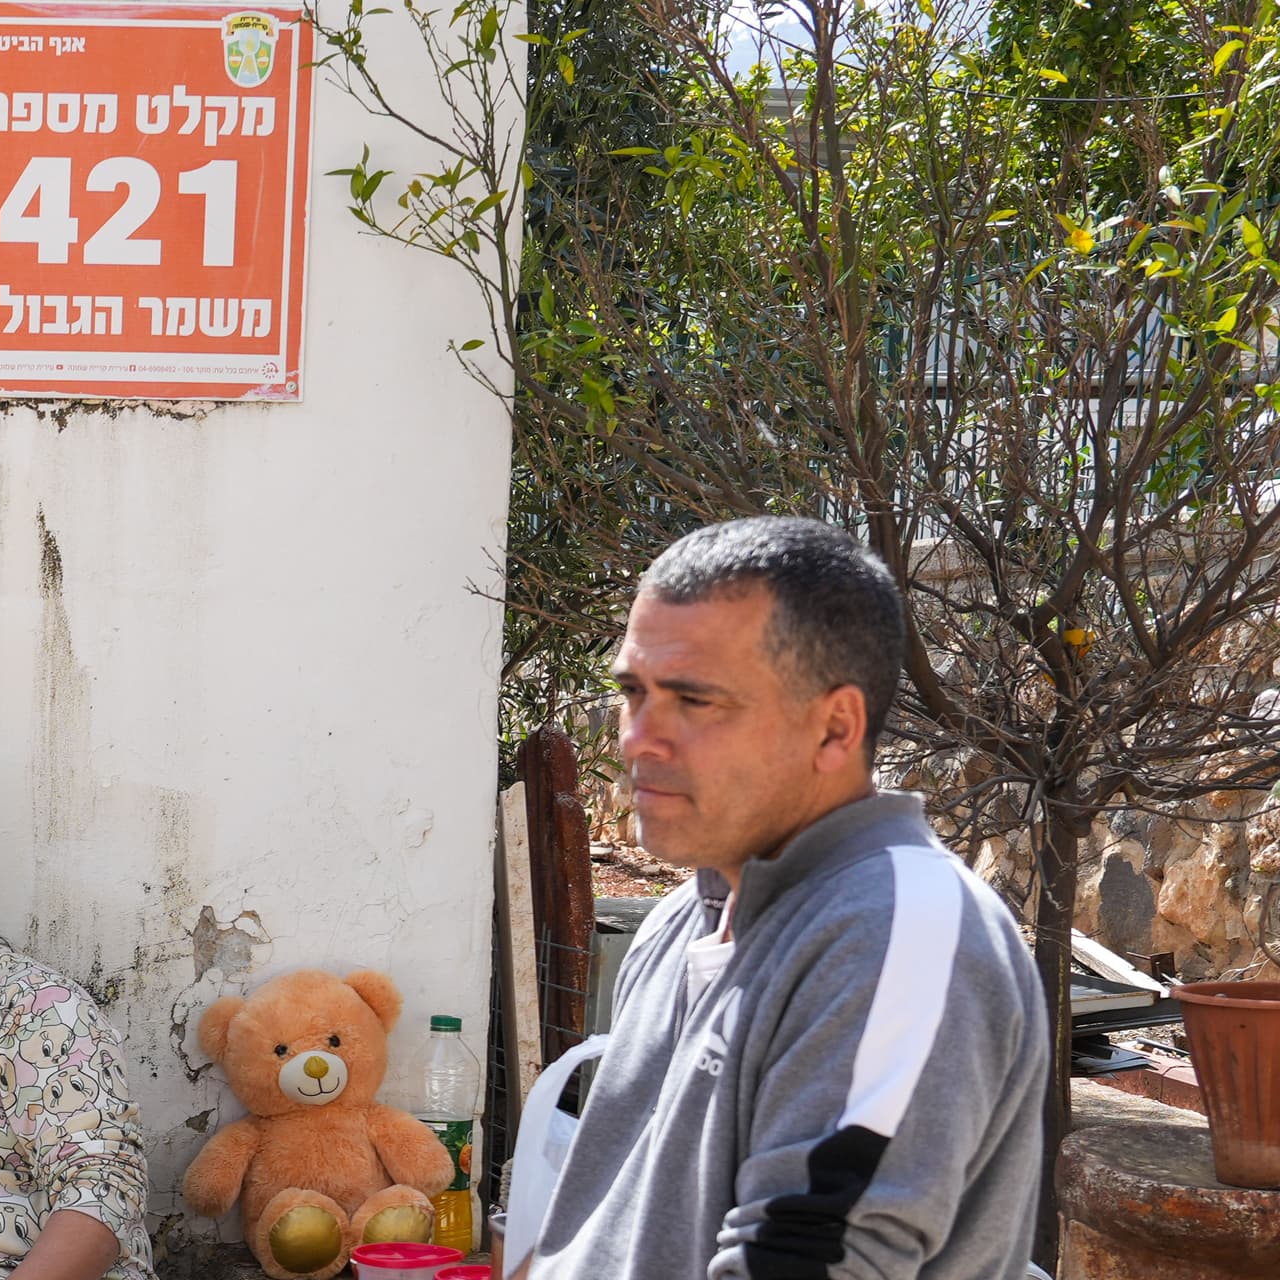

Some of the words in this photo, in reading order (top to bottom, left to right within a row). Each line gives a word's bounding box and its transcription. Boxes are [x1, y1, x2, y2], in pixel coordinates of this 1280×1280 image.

[49, 36, 86, 56] אגף
[135, 85, 276, 147] מקלט
[138, 297, 273, 338] משמר
